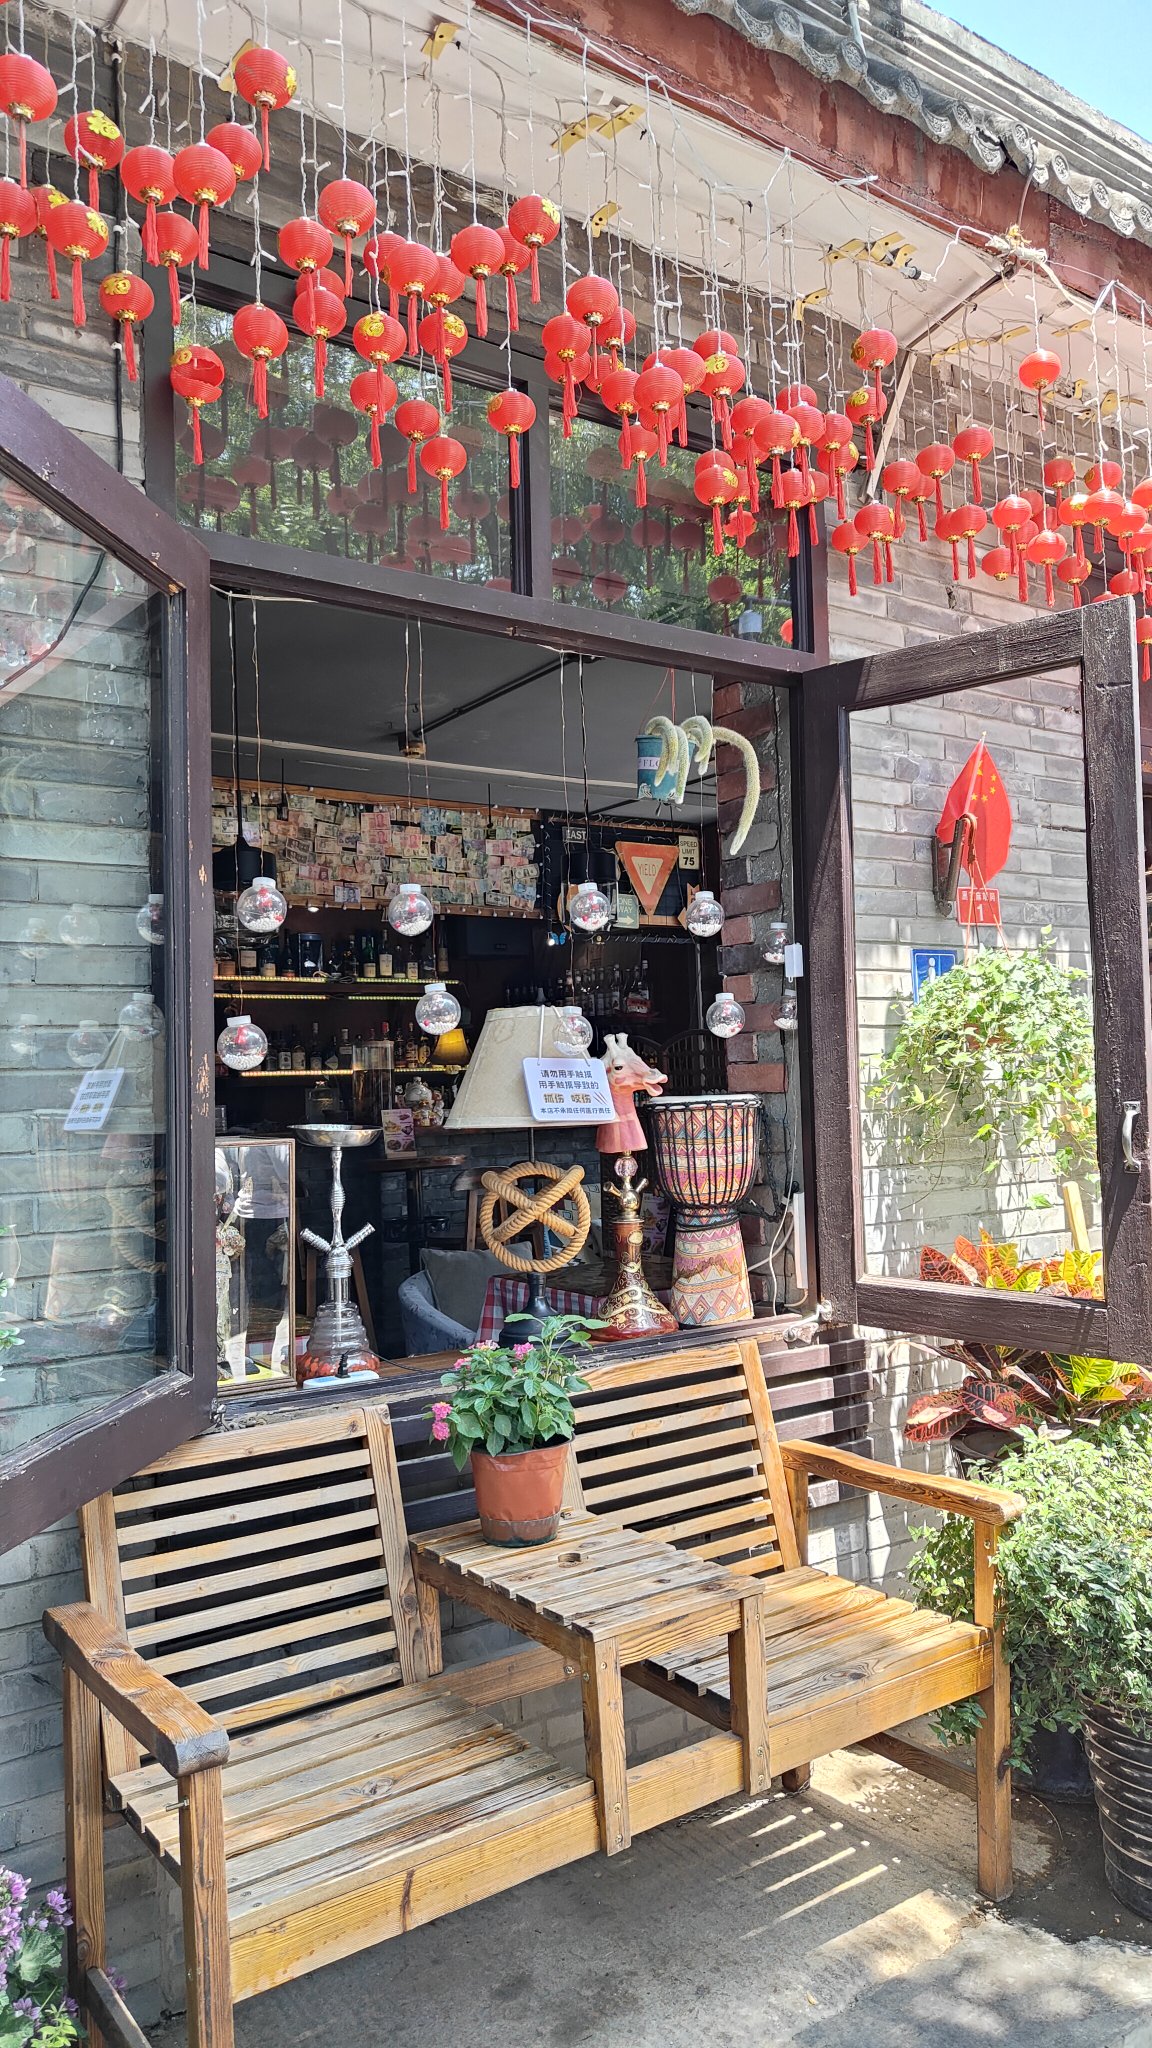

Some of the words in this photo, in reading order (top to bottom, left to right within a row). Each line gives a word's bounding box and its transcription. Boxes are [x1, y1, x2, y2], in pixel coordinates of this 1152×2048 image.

[566, 831, 586, 840] EAST
[680, 840, 698, 848] SPEED
[683, 857, 695, 866] 75
[638, 863, 658, 876] YIELD
[976, 904, 984, 922] 1
[540, 1069, 593, 1079] 请勿用手触摸
[538, 1080, 600, 1090] 用手触摸导致的
[543, 1093, 565, 1104] 抓伤
